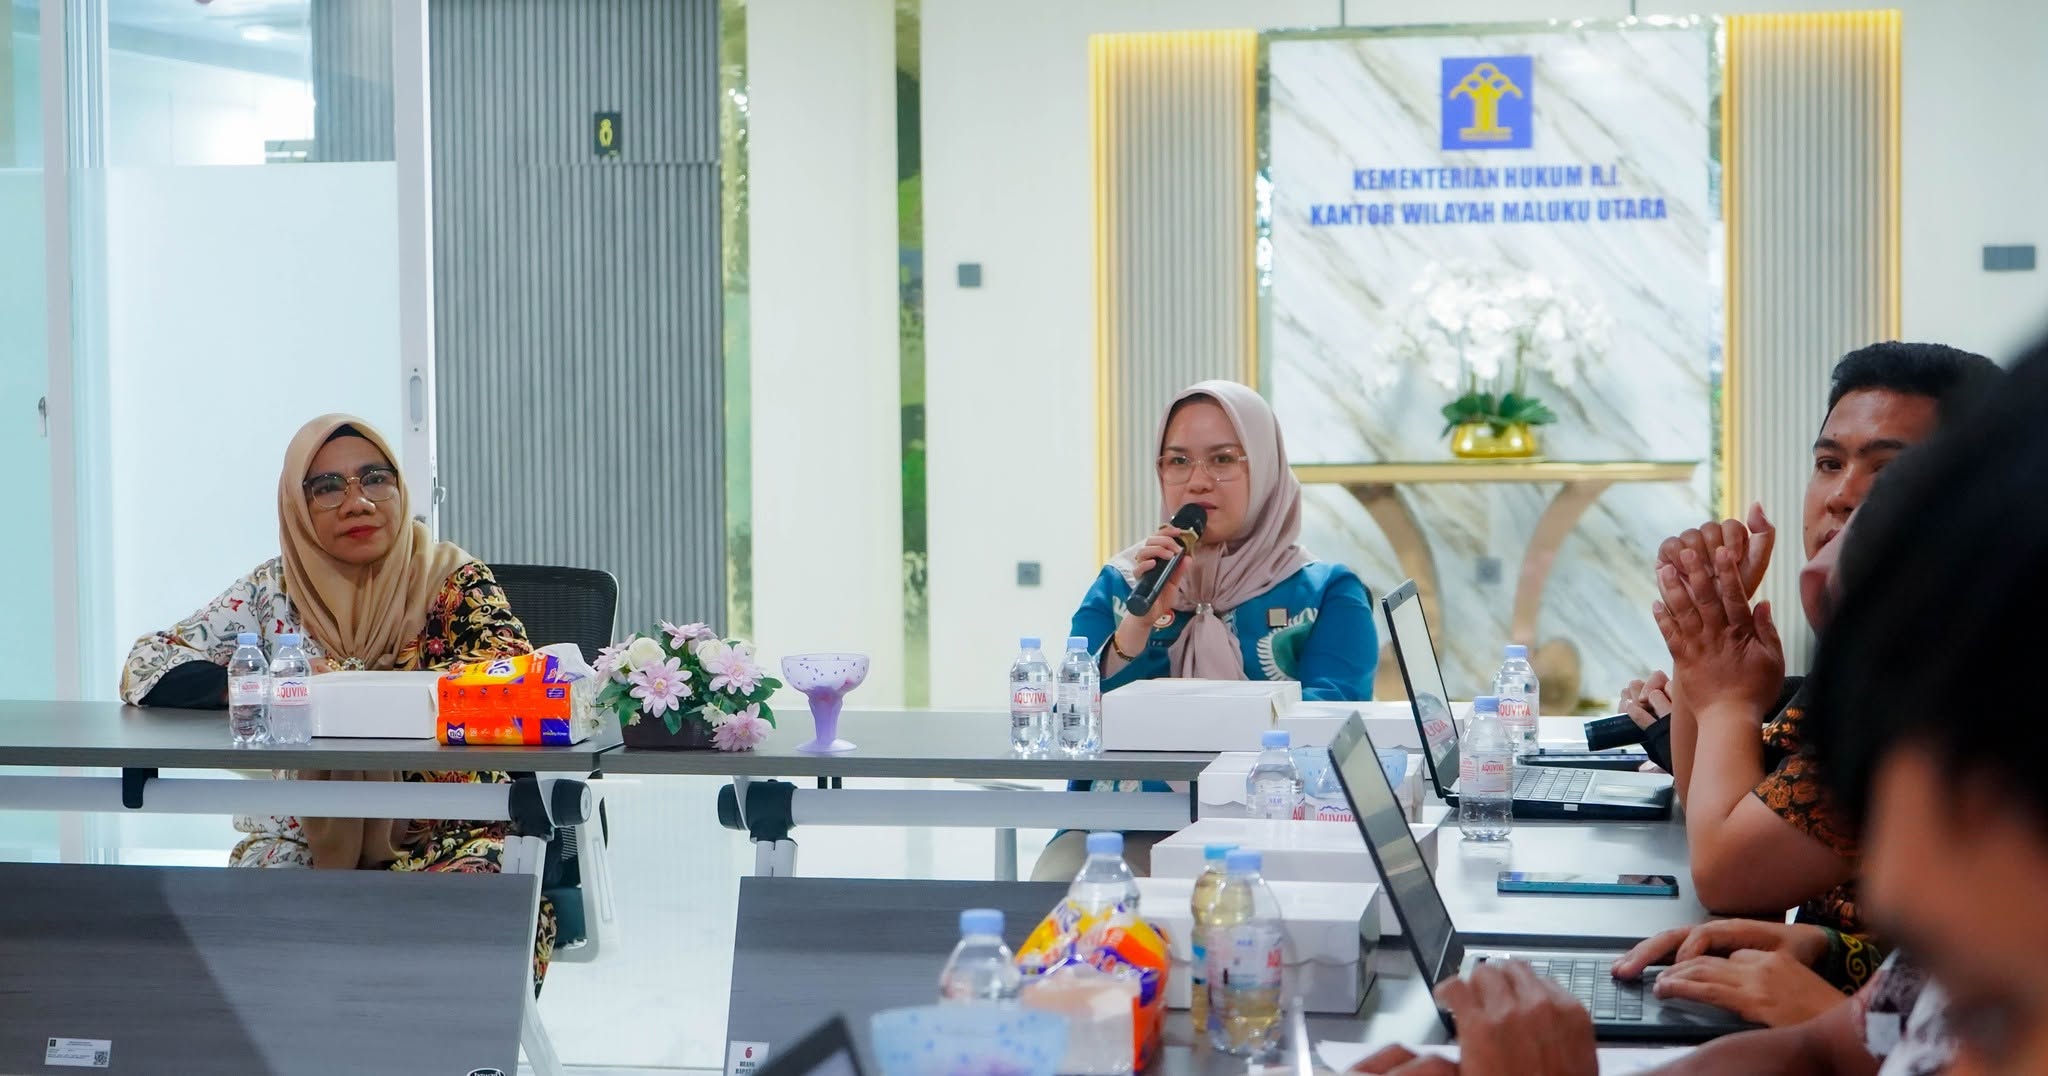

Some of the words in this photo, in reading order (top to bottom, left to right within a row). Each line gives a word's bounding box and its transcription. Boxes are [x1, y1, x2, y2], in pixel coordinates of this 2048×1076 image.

[1354, 167, 1499, 190] KEMENTERIAN
[1504, 165, 1582, 188] HUKUM
[1311, 203, 1394, 225] KANTOR
[1402, 202, 1495, 224] WILAYAH
[1502, 200, 1590, 223] MALUKU
[1597, 198, 1667, 220] UTARA
[277, 687, 308, 698] AQUVIVA
[1014, 692, 1047, 704] AQUVIVA
[1498, 703, 1531, 717] QUVIVA
[745, 1046, 753, 1059] 6
